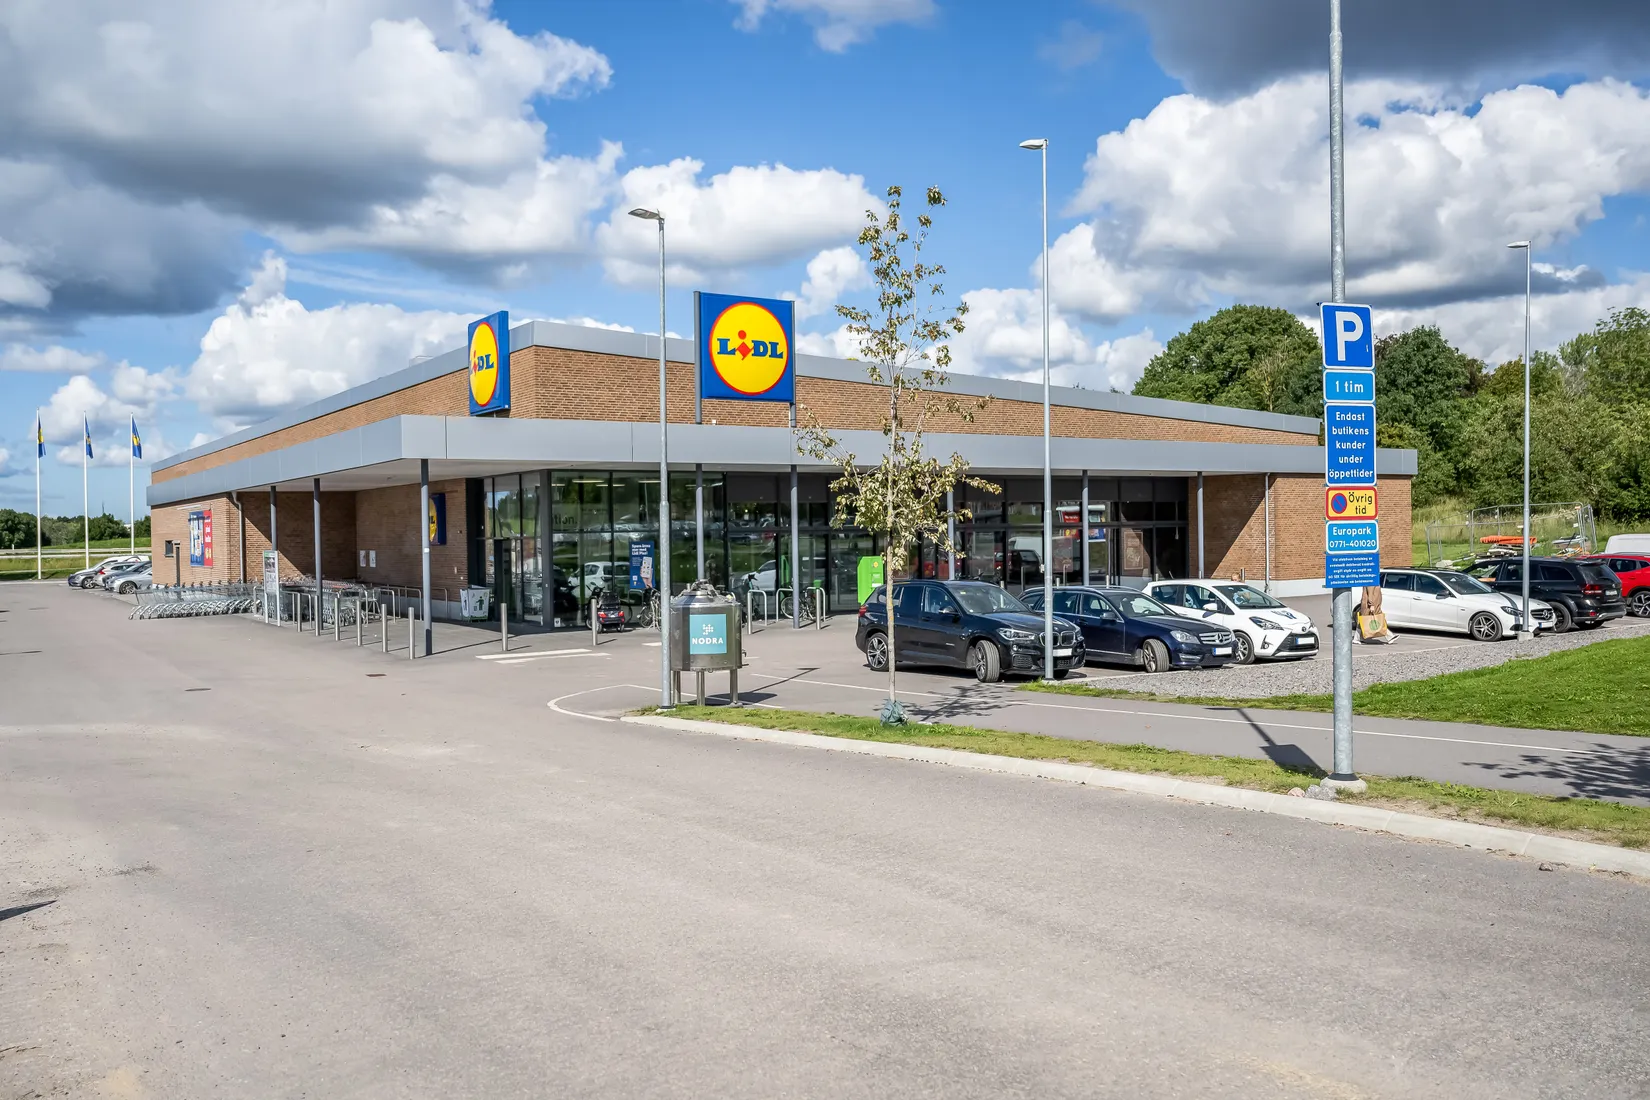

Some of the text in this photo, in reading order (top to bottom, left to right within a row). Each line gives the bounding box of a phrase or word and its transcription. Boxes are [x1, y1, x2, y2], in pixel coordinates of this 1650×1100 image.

[1335, 310, 1364, 361] P
[1335, 380, 1364, 393] 1 tim
[1335, 412, 1365, 421] Endast
[1332, 426, 1370, 435] butikens
[1335, 441, 1366, 449] kunder
[1338, 455, 1364, 463] under
[1329, 469, 1374, 480] öppettider
[1348, 492, 1373, 505] Övrig
[1355, 506, 1367, 514] tid
[1332, 526, 1372, 537] Europark
[1329, 539, 1376, 548] 0771-401020
[692, 637, 724, 645] NODRA
